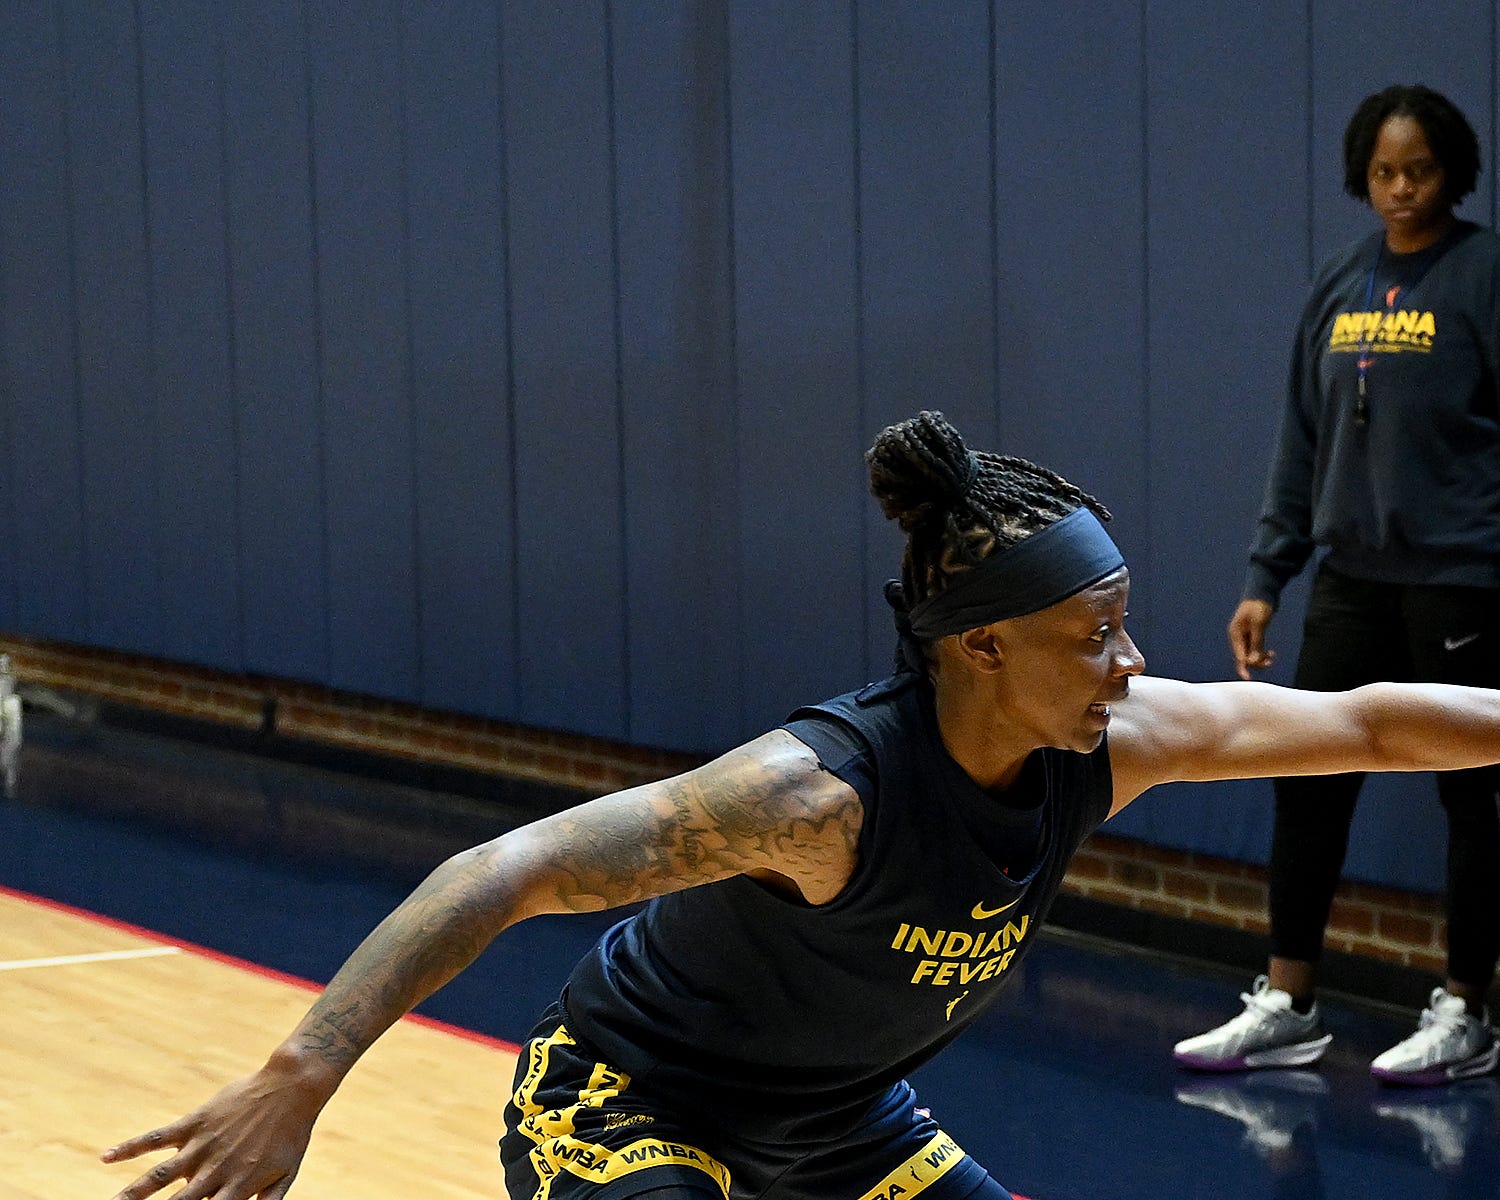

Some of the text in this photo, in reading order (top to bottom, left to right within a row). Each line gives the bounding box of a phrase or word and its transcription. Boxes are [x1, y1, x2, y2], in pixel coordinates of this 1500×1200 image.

[891, 914, 1031, 959] INDIAN
[910, 948, 1017, 986] FEVER
[620, 1143, 704, 1165] WNBA
